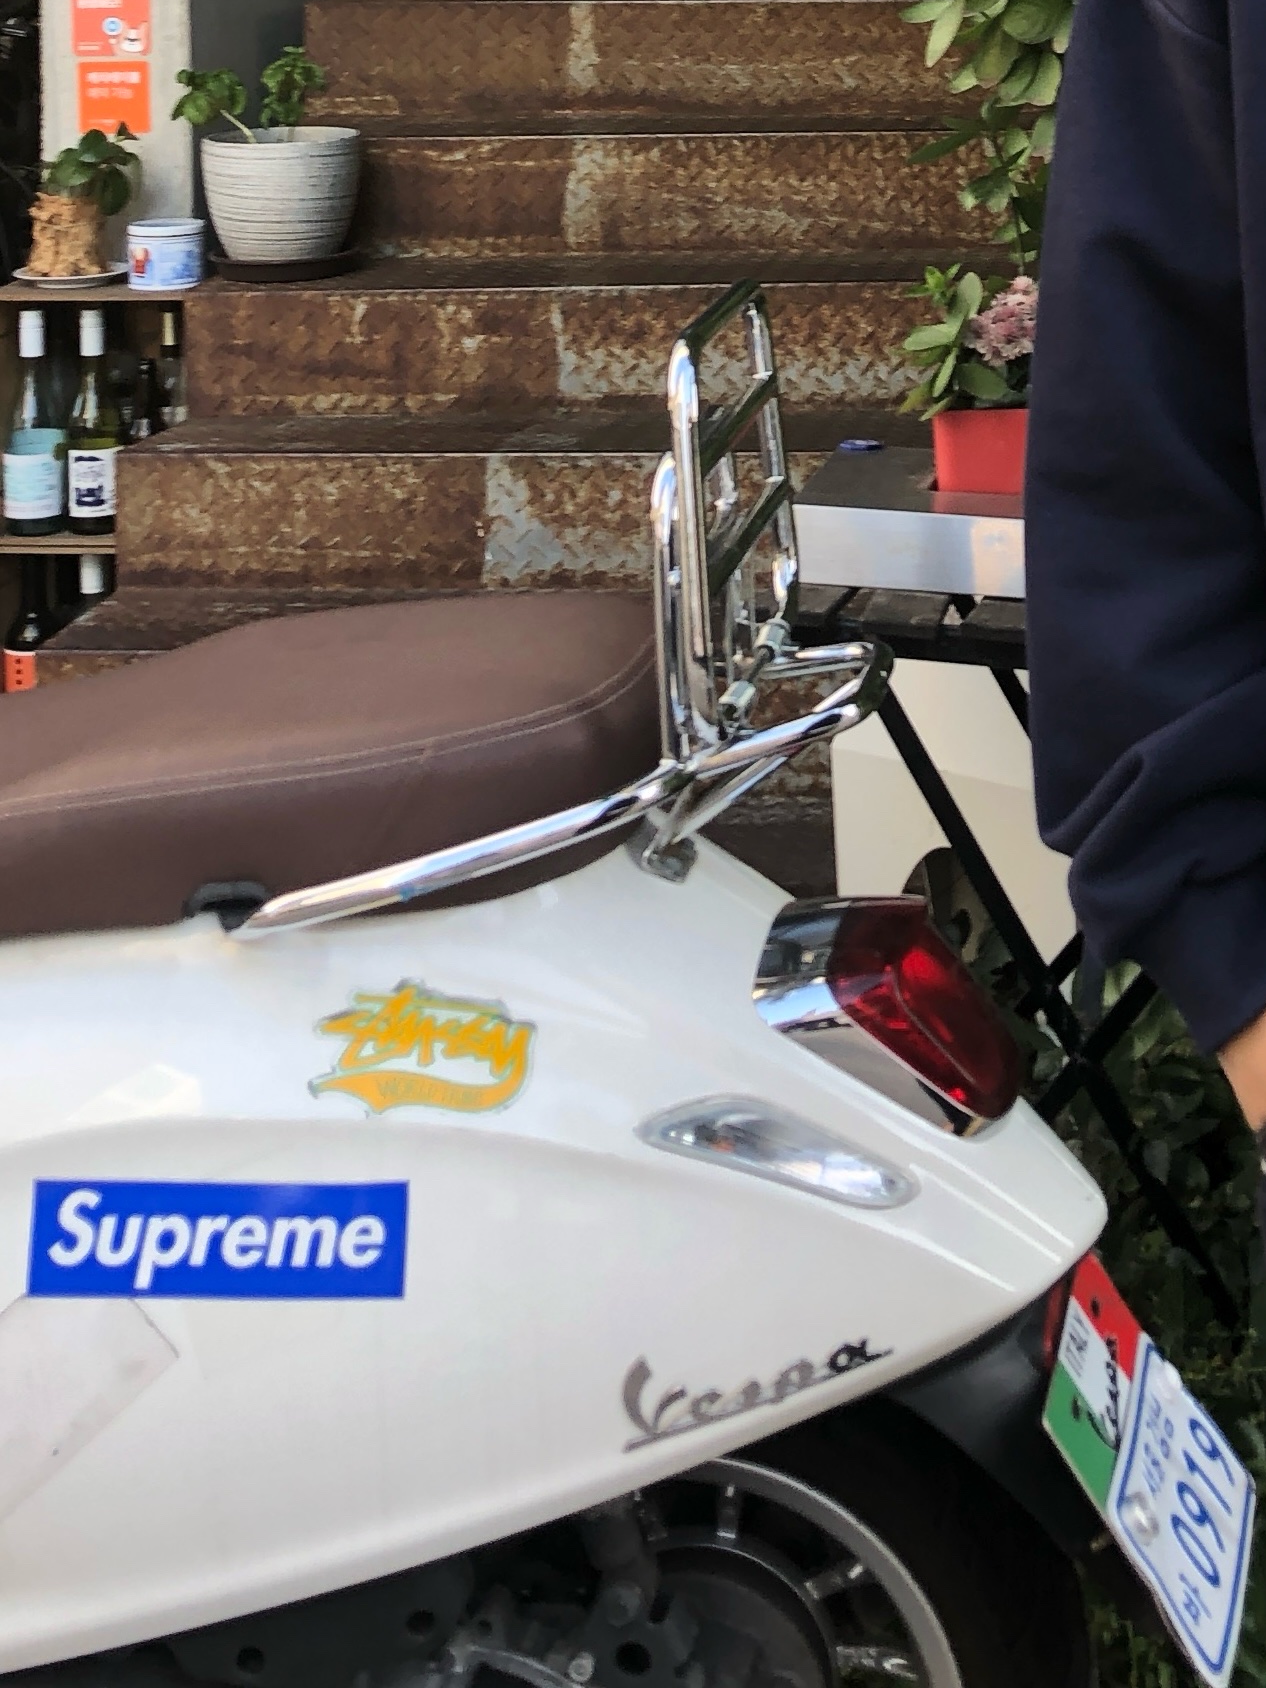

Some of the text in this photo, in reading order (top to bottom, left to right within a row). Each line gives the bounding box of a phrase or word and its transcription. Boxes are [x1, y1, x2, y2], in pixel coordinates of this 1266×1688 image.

[48, 1189, 387, 1290] Supreme
[622, 1336, 894, 1453] Vespa
[1169, 1416, 1237, 1589] 0919
